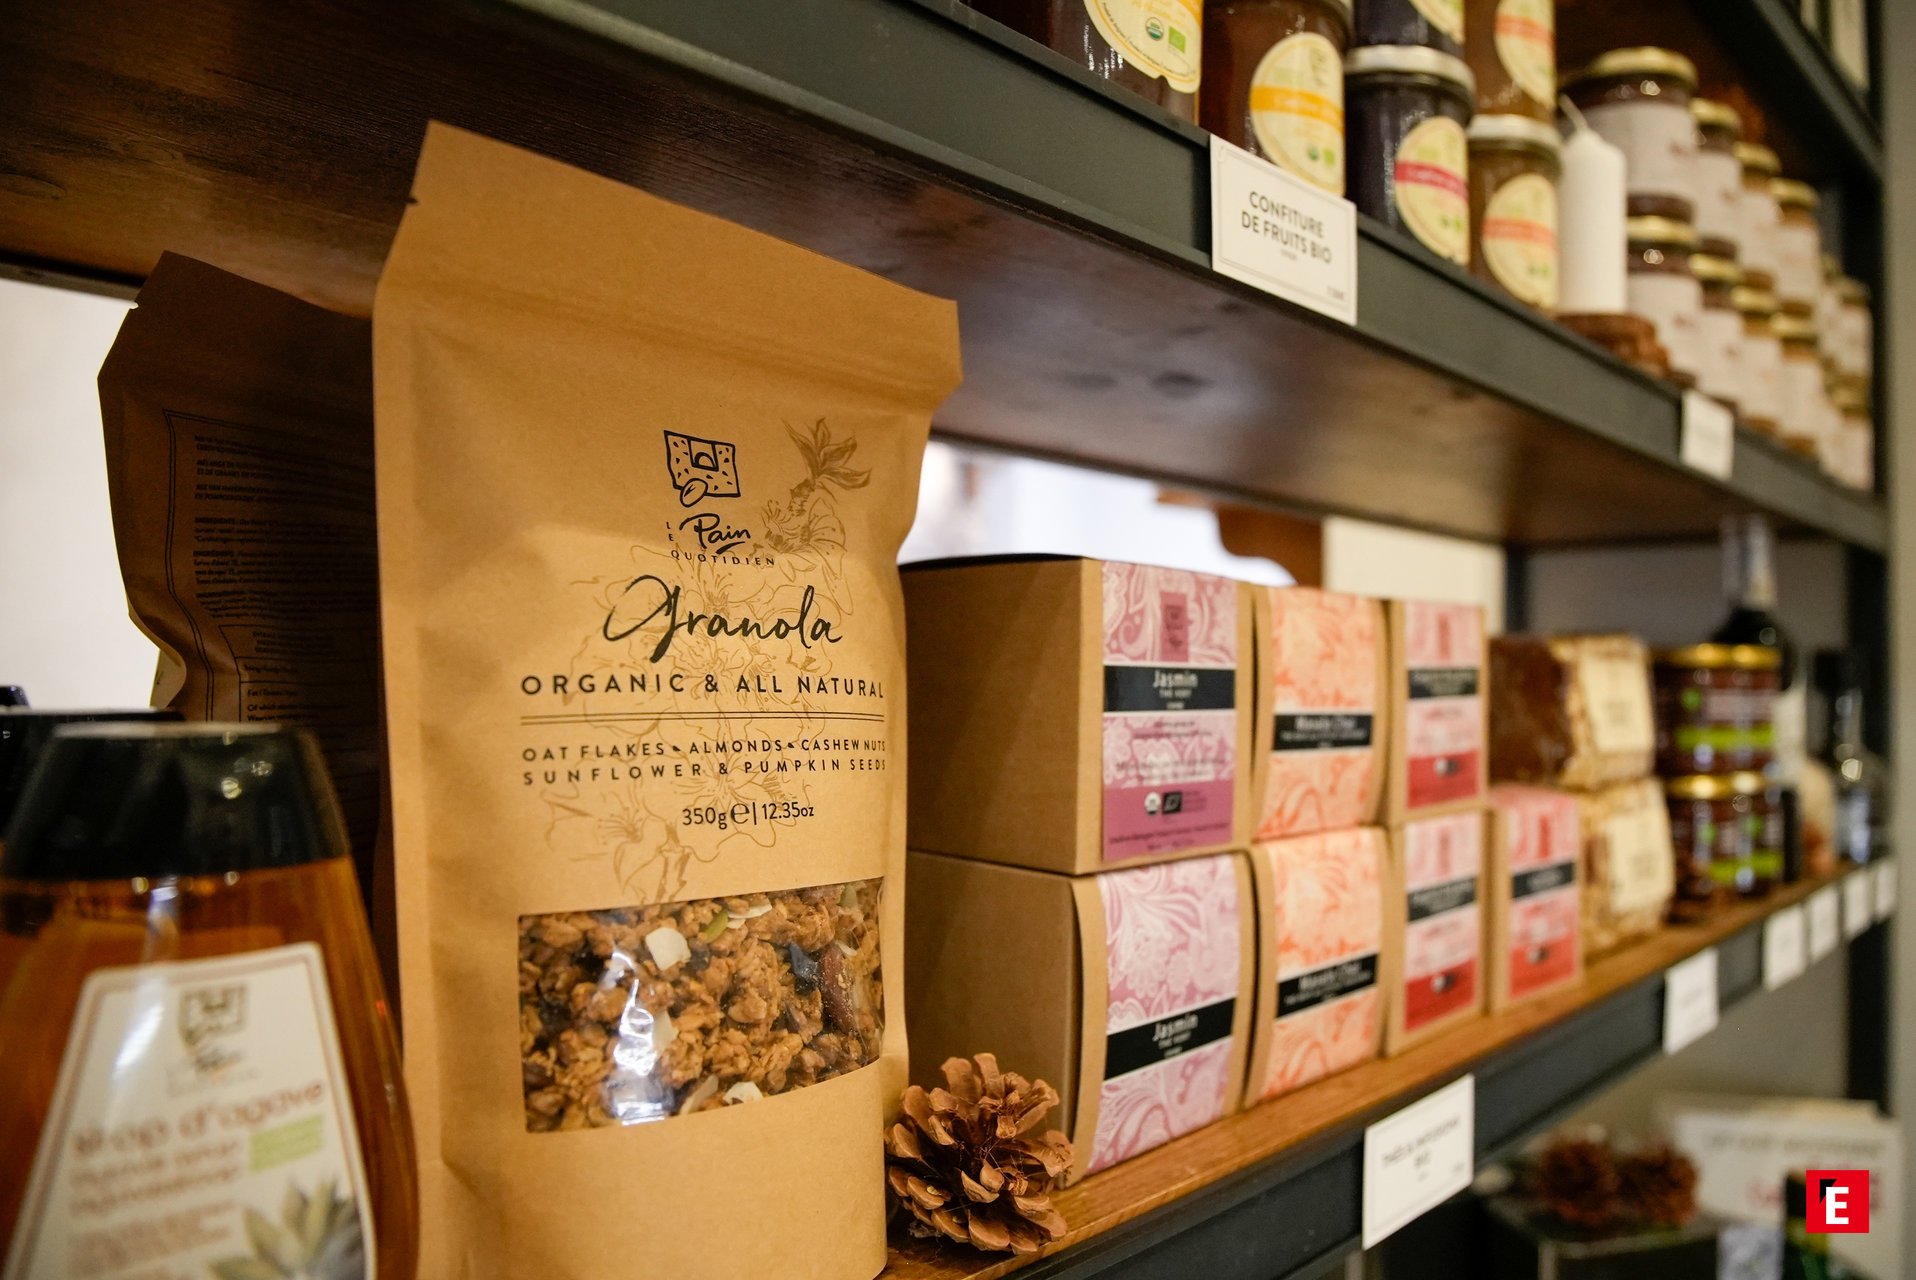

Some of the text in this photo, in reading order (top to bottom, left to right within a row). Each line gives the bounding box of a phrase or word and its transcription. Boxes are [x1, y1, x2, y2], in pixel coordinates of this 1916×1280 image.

[1249, 190, 1324, 239] CONFITURE
[1242, 211, 1260, 234] DE
[1263, 220, 1307, 254] FRUITS
[1311, 240, 1333, 264] BIO
[679, 512, 752, 550] Pain
[670, 549, 775, 566] QUOTIDIEN
[602, 574, 843, 664] Granola
[520, 673, 884, 699] ORGANIC & ALL NATURAL
[1153, 669, 1198, 689] Jasmin
[522, 738, 886, 762] OAT FLAKES ALMONDS CASHEW NUTS
[523, 758, 886, 786] SUNFLOWER & PUMPKIN SEEDS
[761, 801, 815, 820] 12.35oz
[1152, 1012, 1198, 1042] Jasmin
